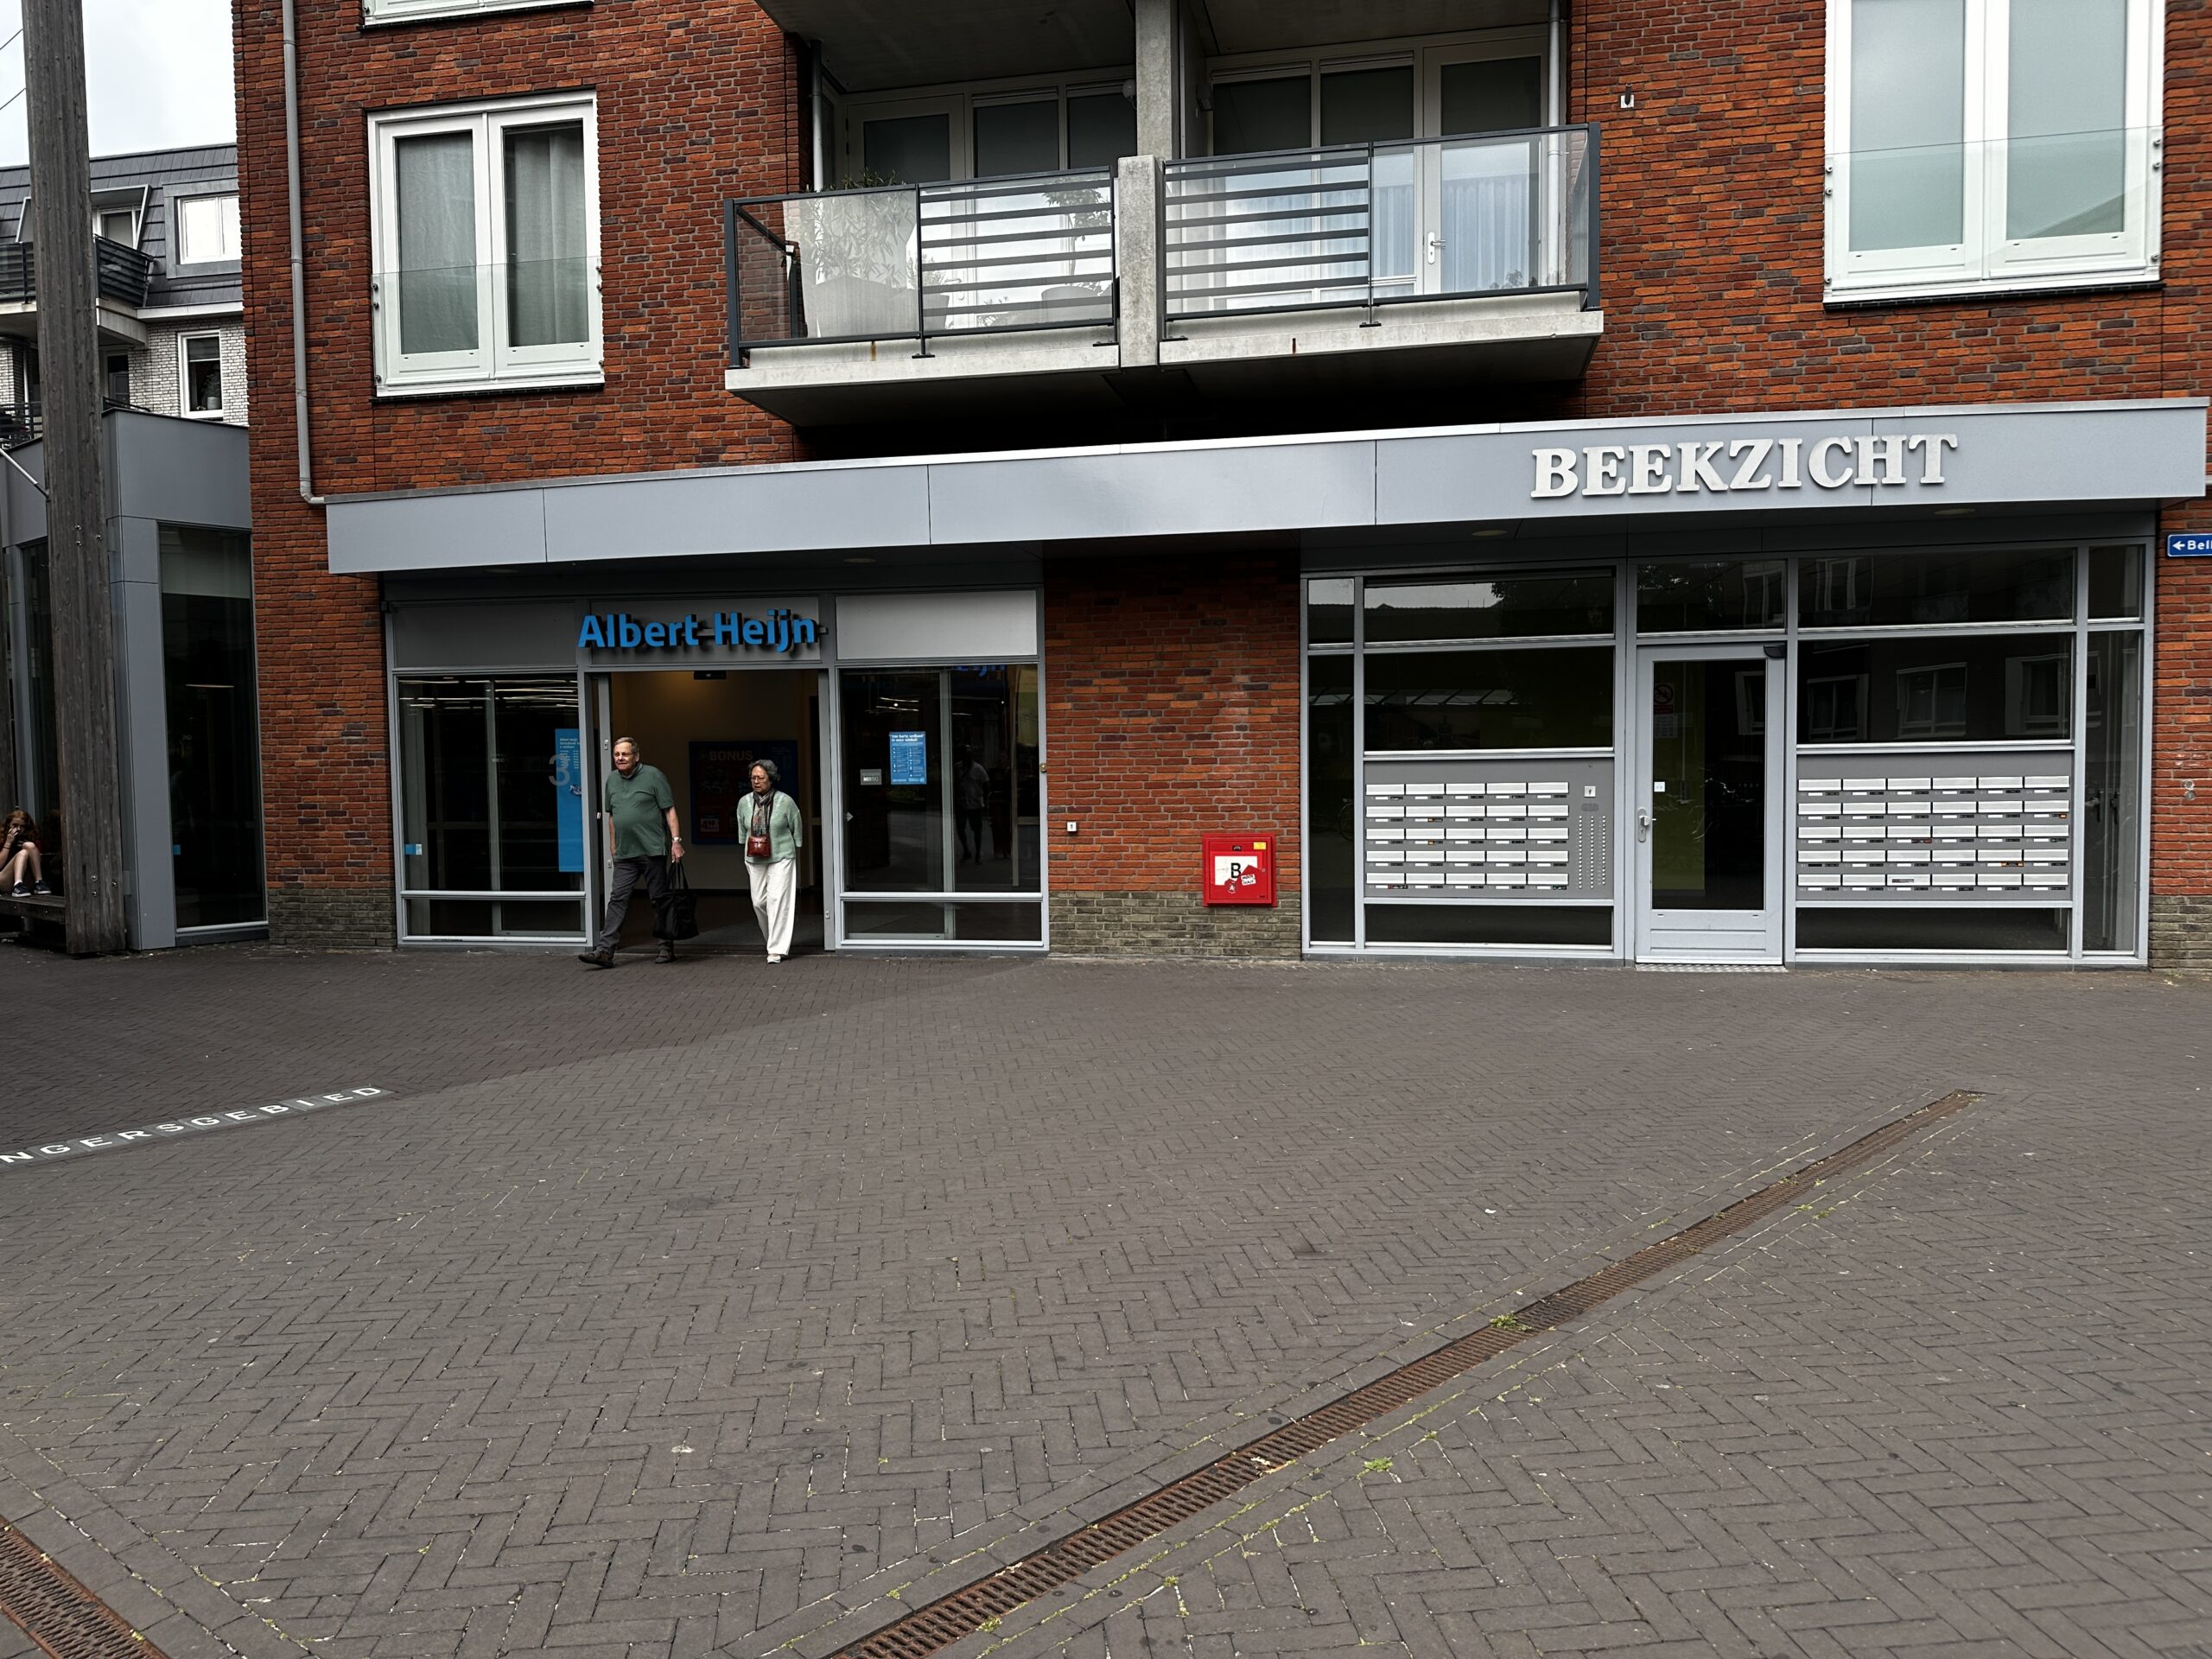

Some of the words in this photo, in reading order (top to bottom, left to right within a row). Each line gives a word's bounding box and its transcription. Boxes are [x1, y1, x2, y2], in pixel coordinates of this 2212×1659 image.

[1530, 433, 1958, 499] BEEKZICHT
[578, 613, 699, 648] Albert
[714, 609, 815, 652] Heijn
[709, 750, 753, 760] BONUS
[1230, 862, 1242, 879] B
[0, 1086, 381, 1163] NGERSGEBIED
